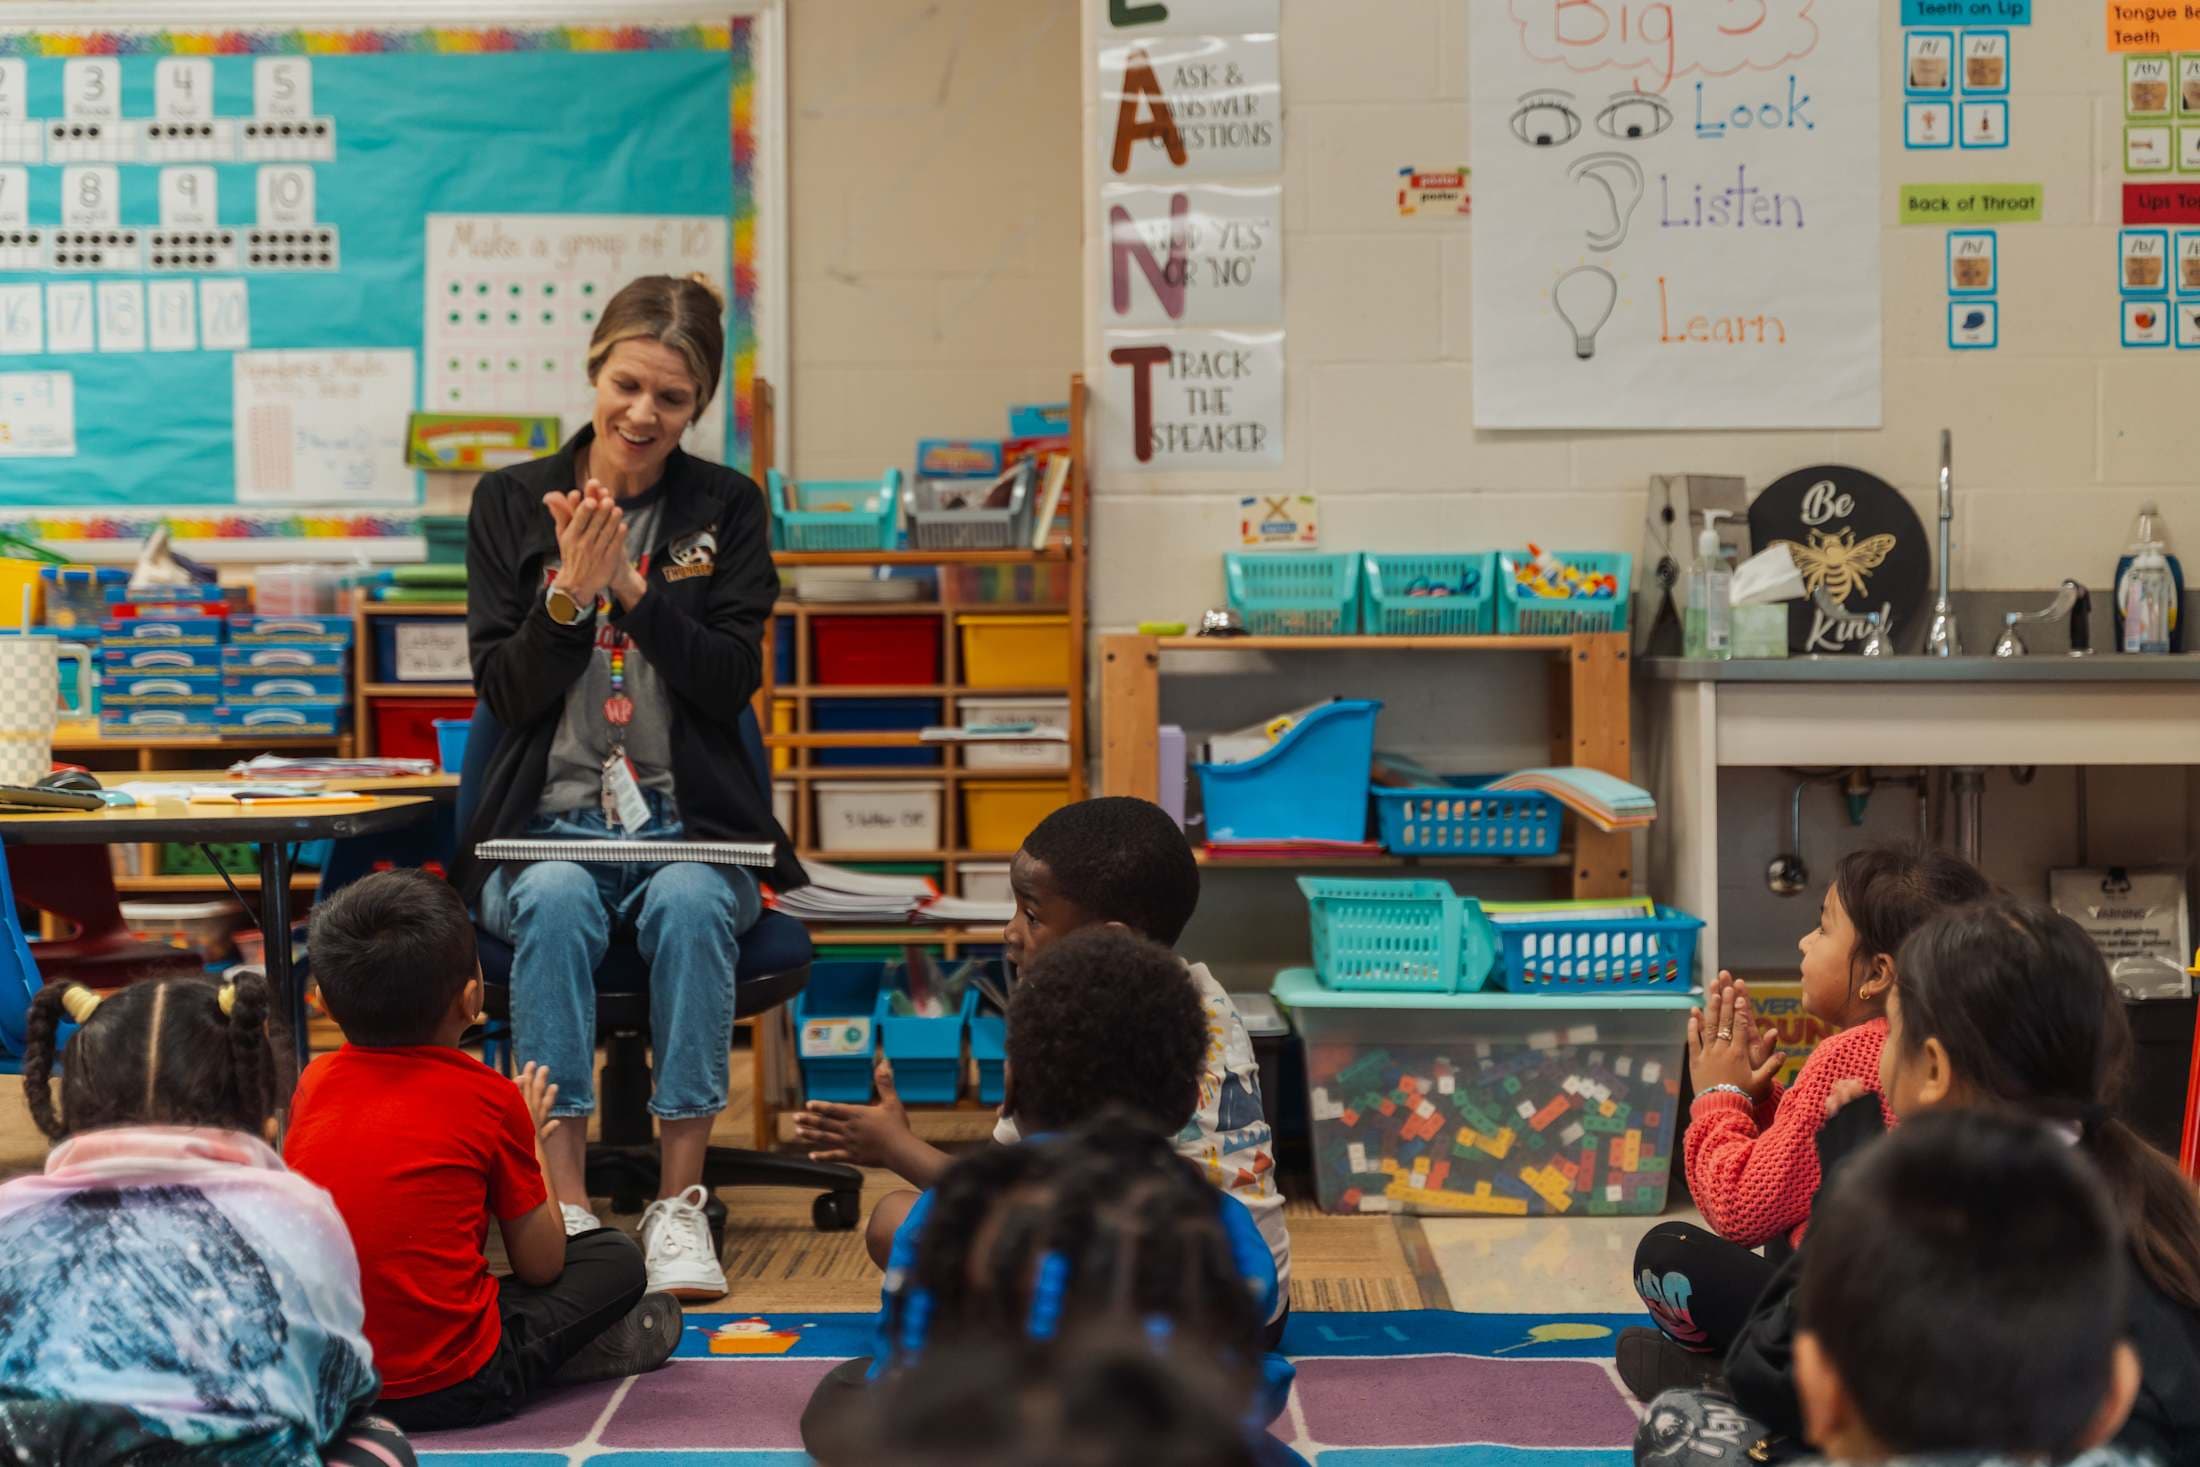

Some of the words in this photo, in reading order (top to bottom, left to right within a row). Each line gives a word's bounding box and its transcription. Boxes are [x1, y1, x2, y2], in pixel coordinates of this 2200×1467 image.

[1917, 1, 1963, 16] Teeth
[1969, 3, 1991, 15] on
[1997, 0, 2023, 19] Lip
[2114, 6, 2177, 23] Tongue
[2115, 30, 2160, 47] Teeth
[84, 66, 105, 101] 3
[173, 67, 194, 99] 4
[273, 65, 296, 101] 5
[1174, 64, 1217, 88] ASK
[1225, 63, 1243, 85] &
[1695, 75, 1815, 131] Look
[80, 171, 102, 208] 8
[177, 173, 198, 208] 9
[268, 173, 304, 208] 10
[1660, 164, 1804, 228] Listen
[1909, 197, 1949, 211] Back
[1958, 196, 1974, 210] of
[1983, 195, 2036, 211] Throat
[1658, 276, 1786, 344] Learn
[1185, 387, 1233, 416] THE
[1151, 422, 1267, 453] SPEAKER
[1802, 479, 1855, 526] Be
